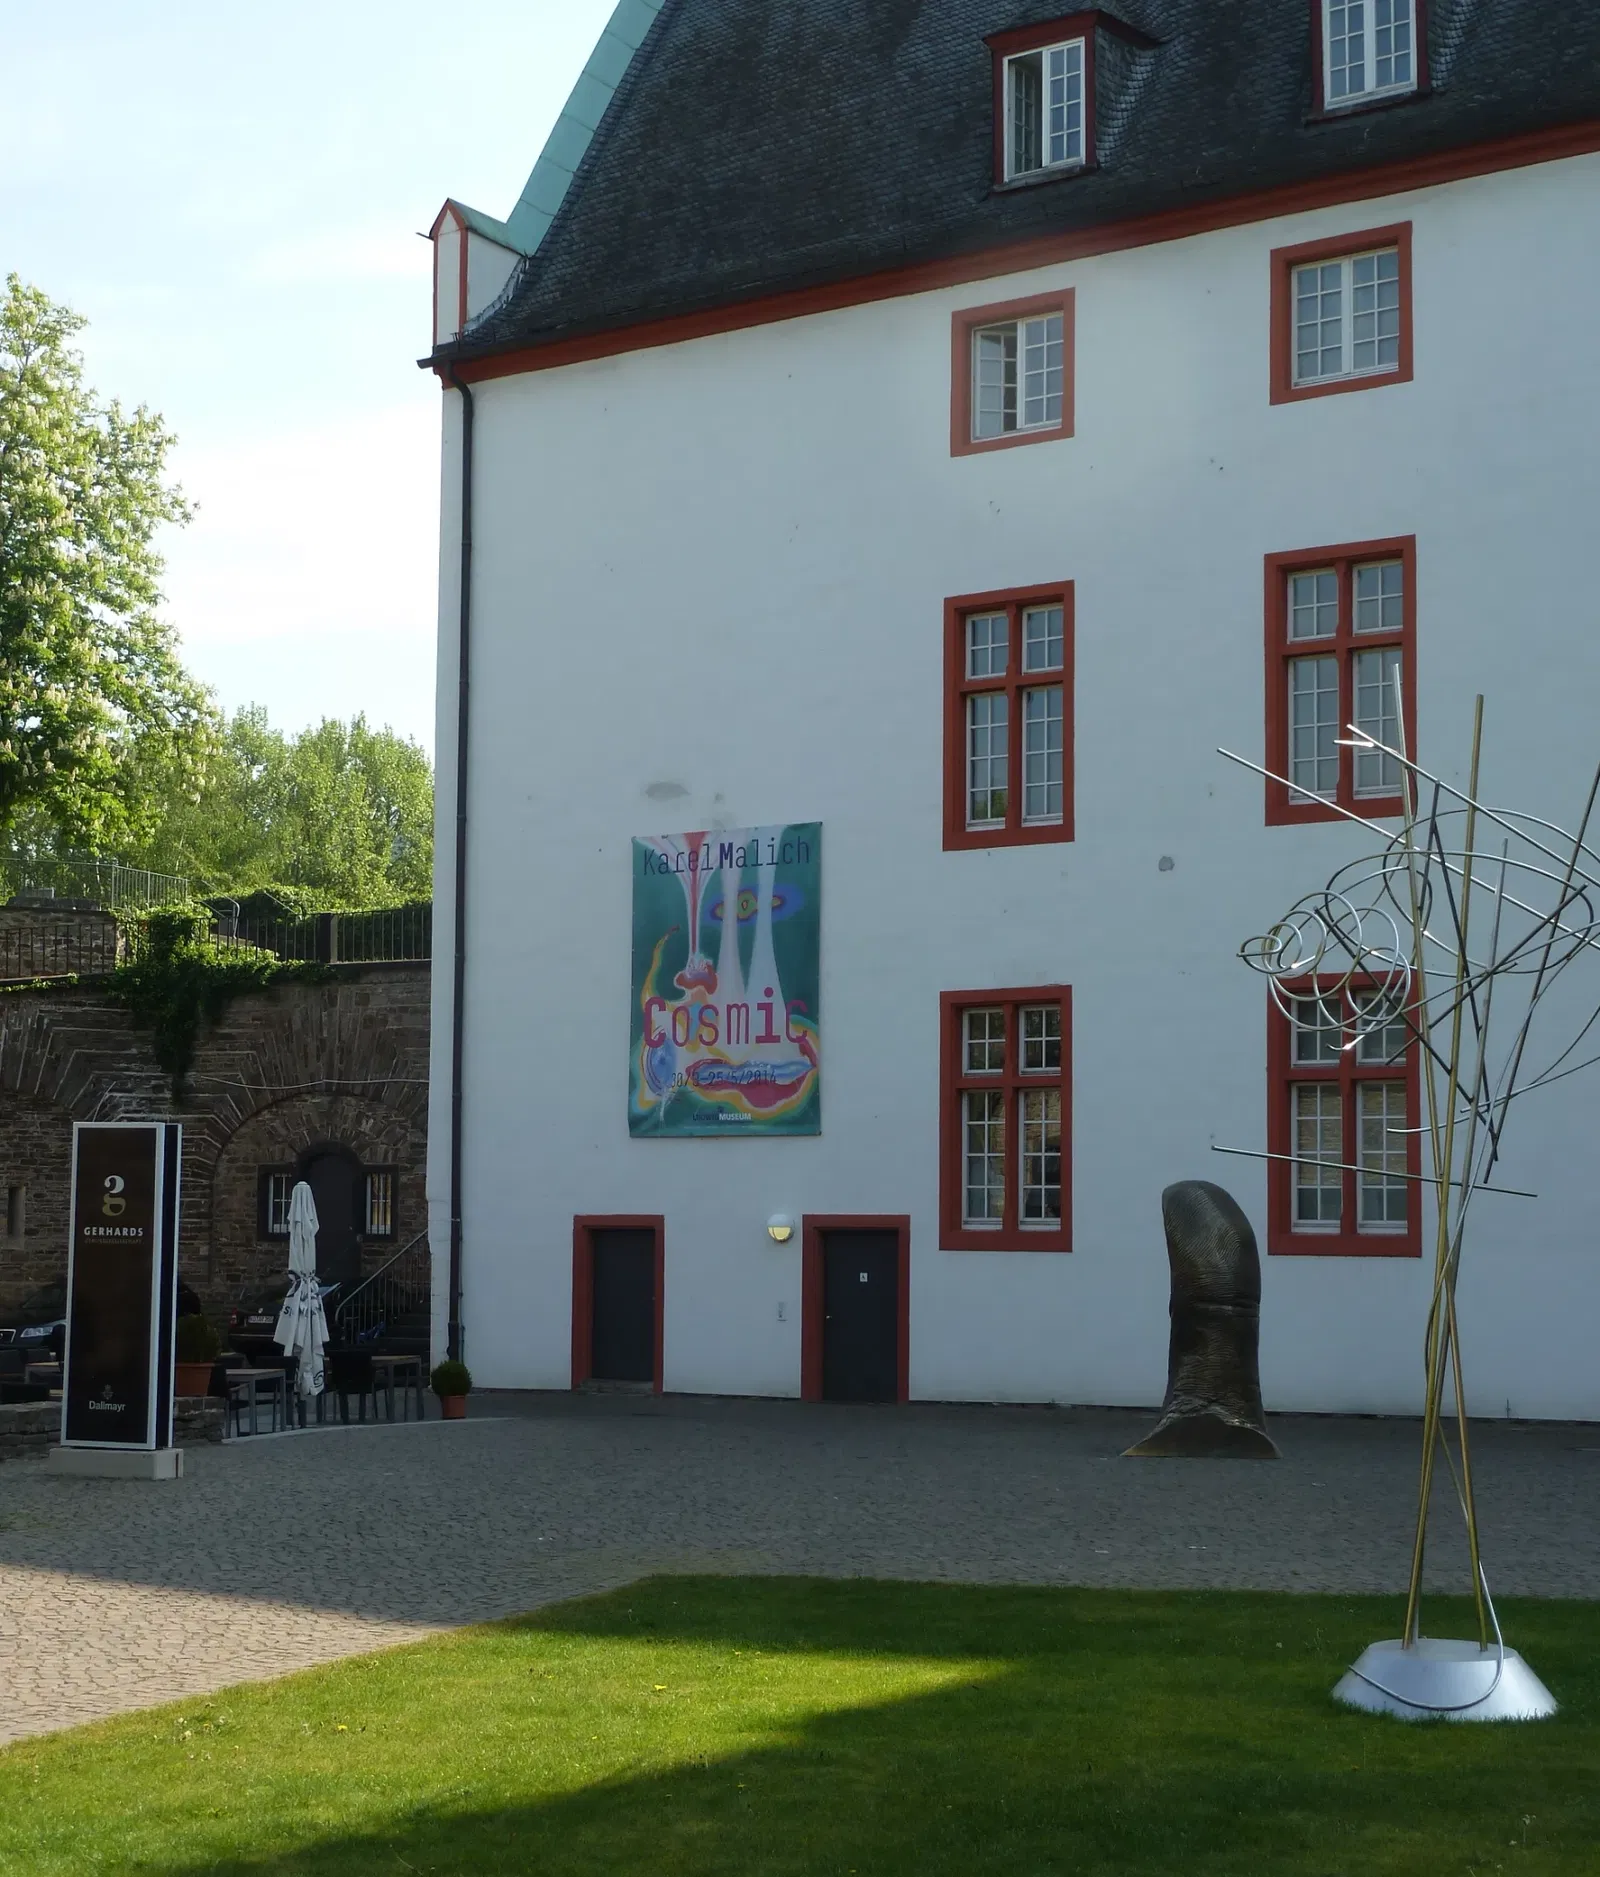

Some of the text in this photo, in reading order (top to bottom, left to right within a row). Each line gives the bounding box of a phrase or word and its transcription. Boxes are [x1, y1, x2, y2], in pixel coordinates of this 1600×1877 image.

[643, 835, 810, 876] Karel Malich
[643, 986, 809, 1049] Cosmic
[83, 1226, 144, 1237] GERHARDS
[89, 1400, 127, 1413] Dallmayr
